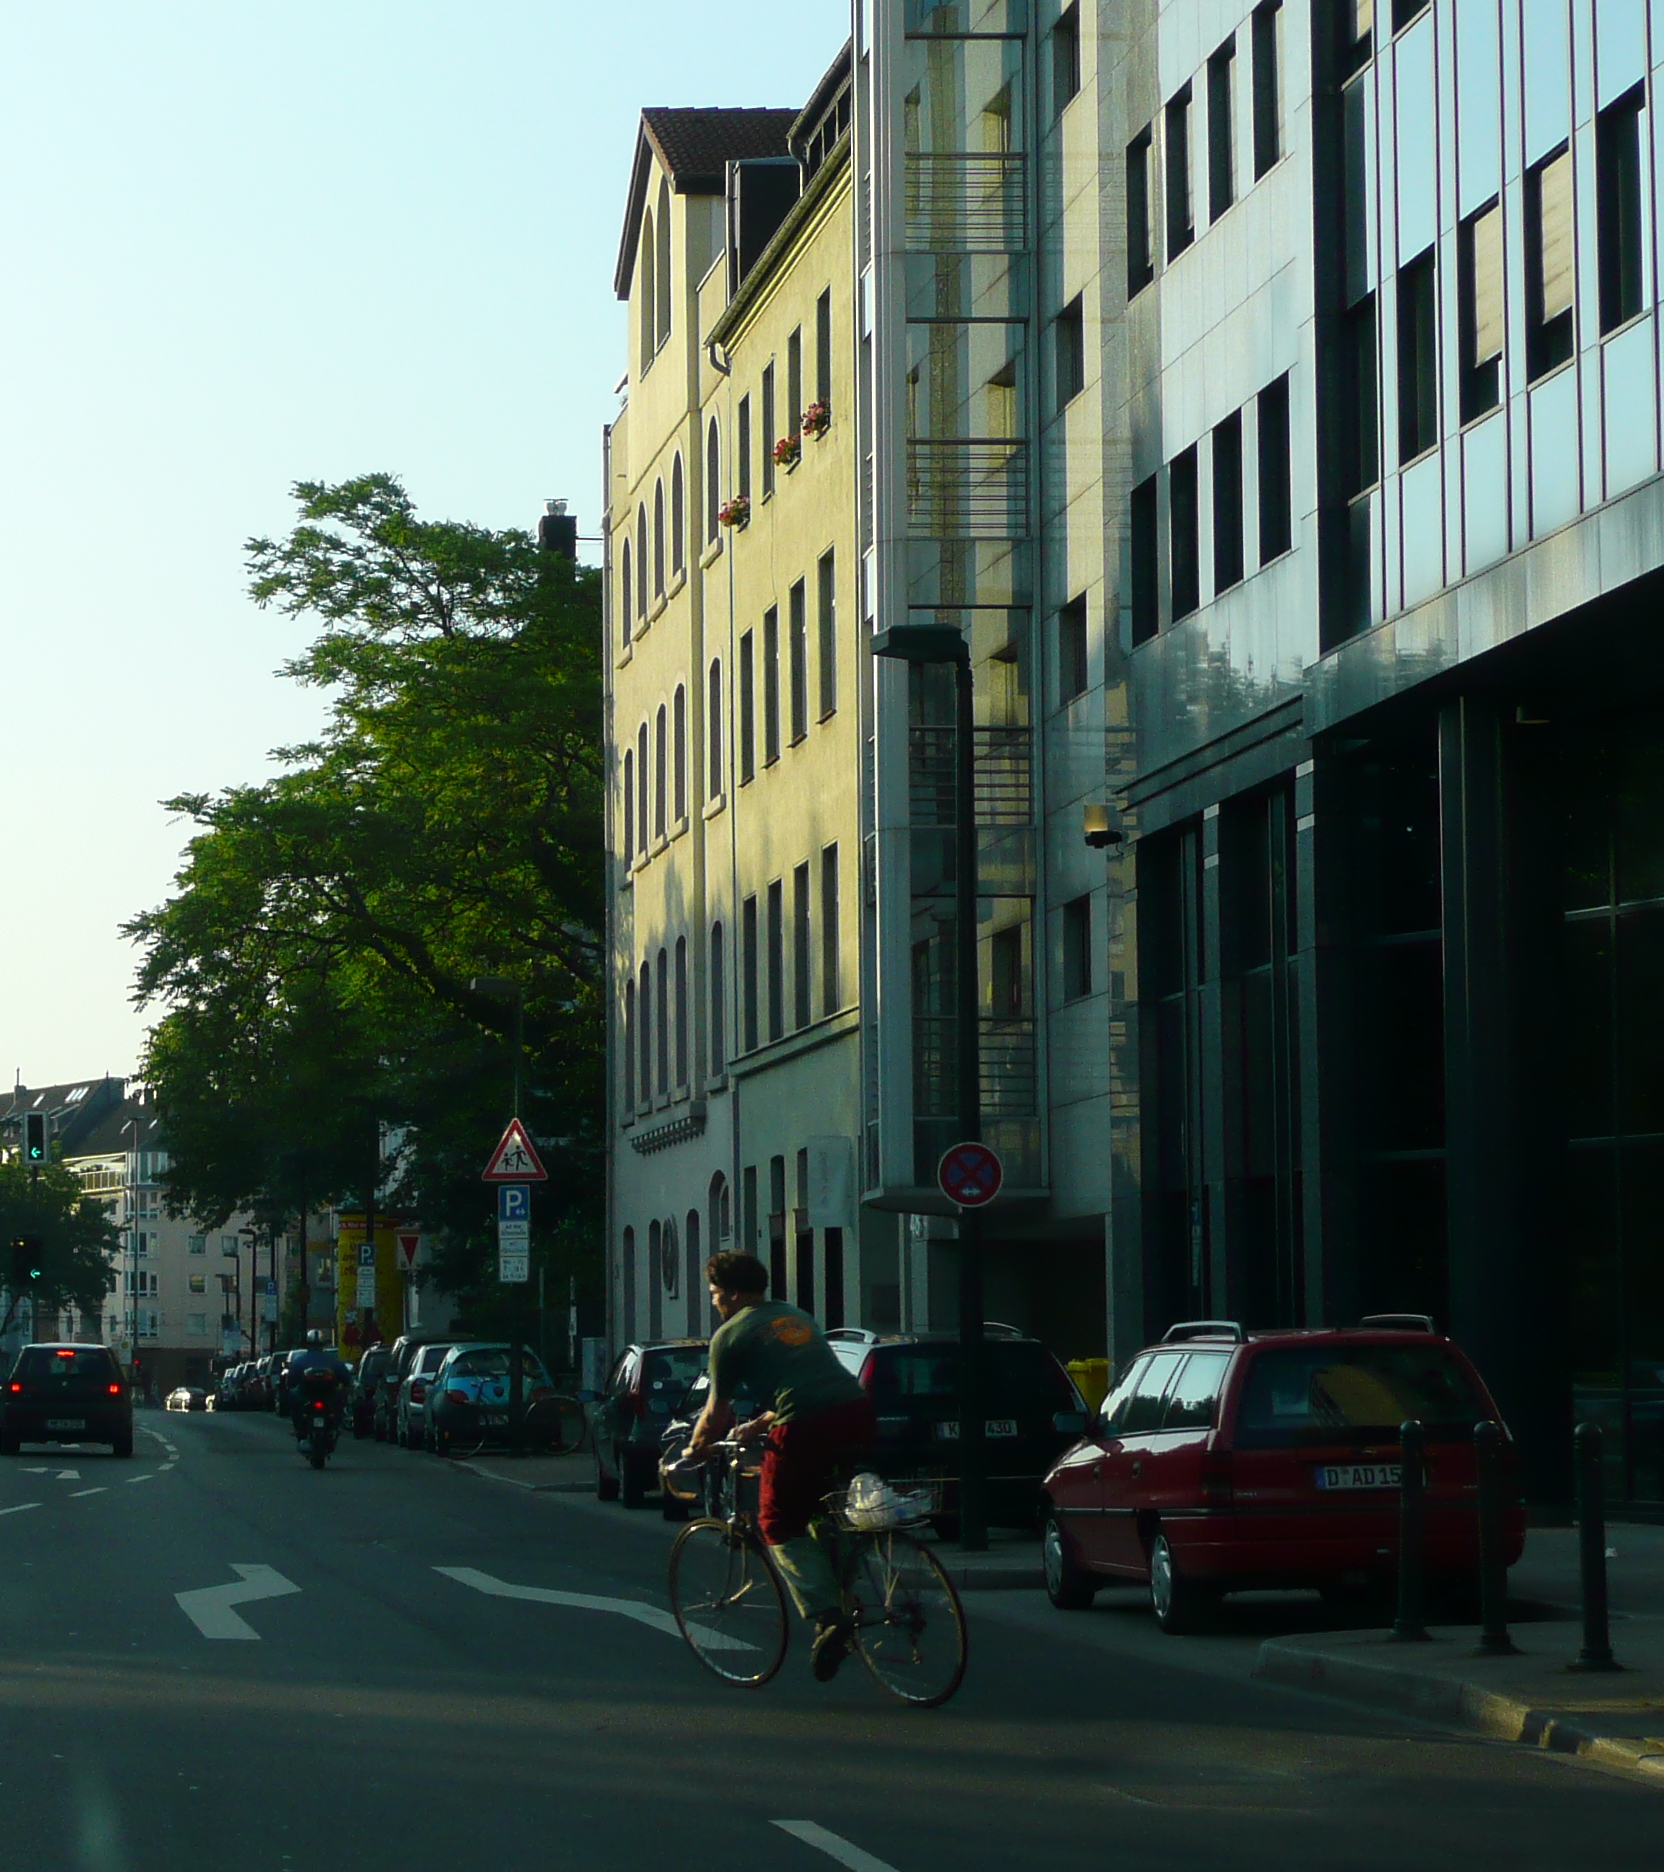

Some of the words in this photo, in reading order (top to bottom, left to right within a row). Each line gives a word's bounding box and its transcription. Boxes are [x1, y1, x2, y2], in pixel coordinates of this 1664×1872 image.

[506, 1190, 522, 1217] P
[361, 1245, 371, 1264] P
[947, 1422, 959, 1436] K
[1326, 1468, 1339, 1486] D
[1352, 1467, 1375, 1486] AD
